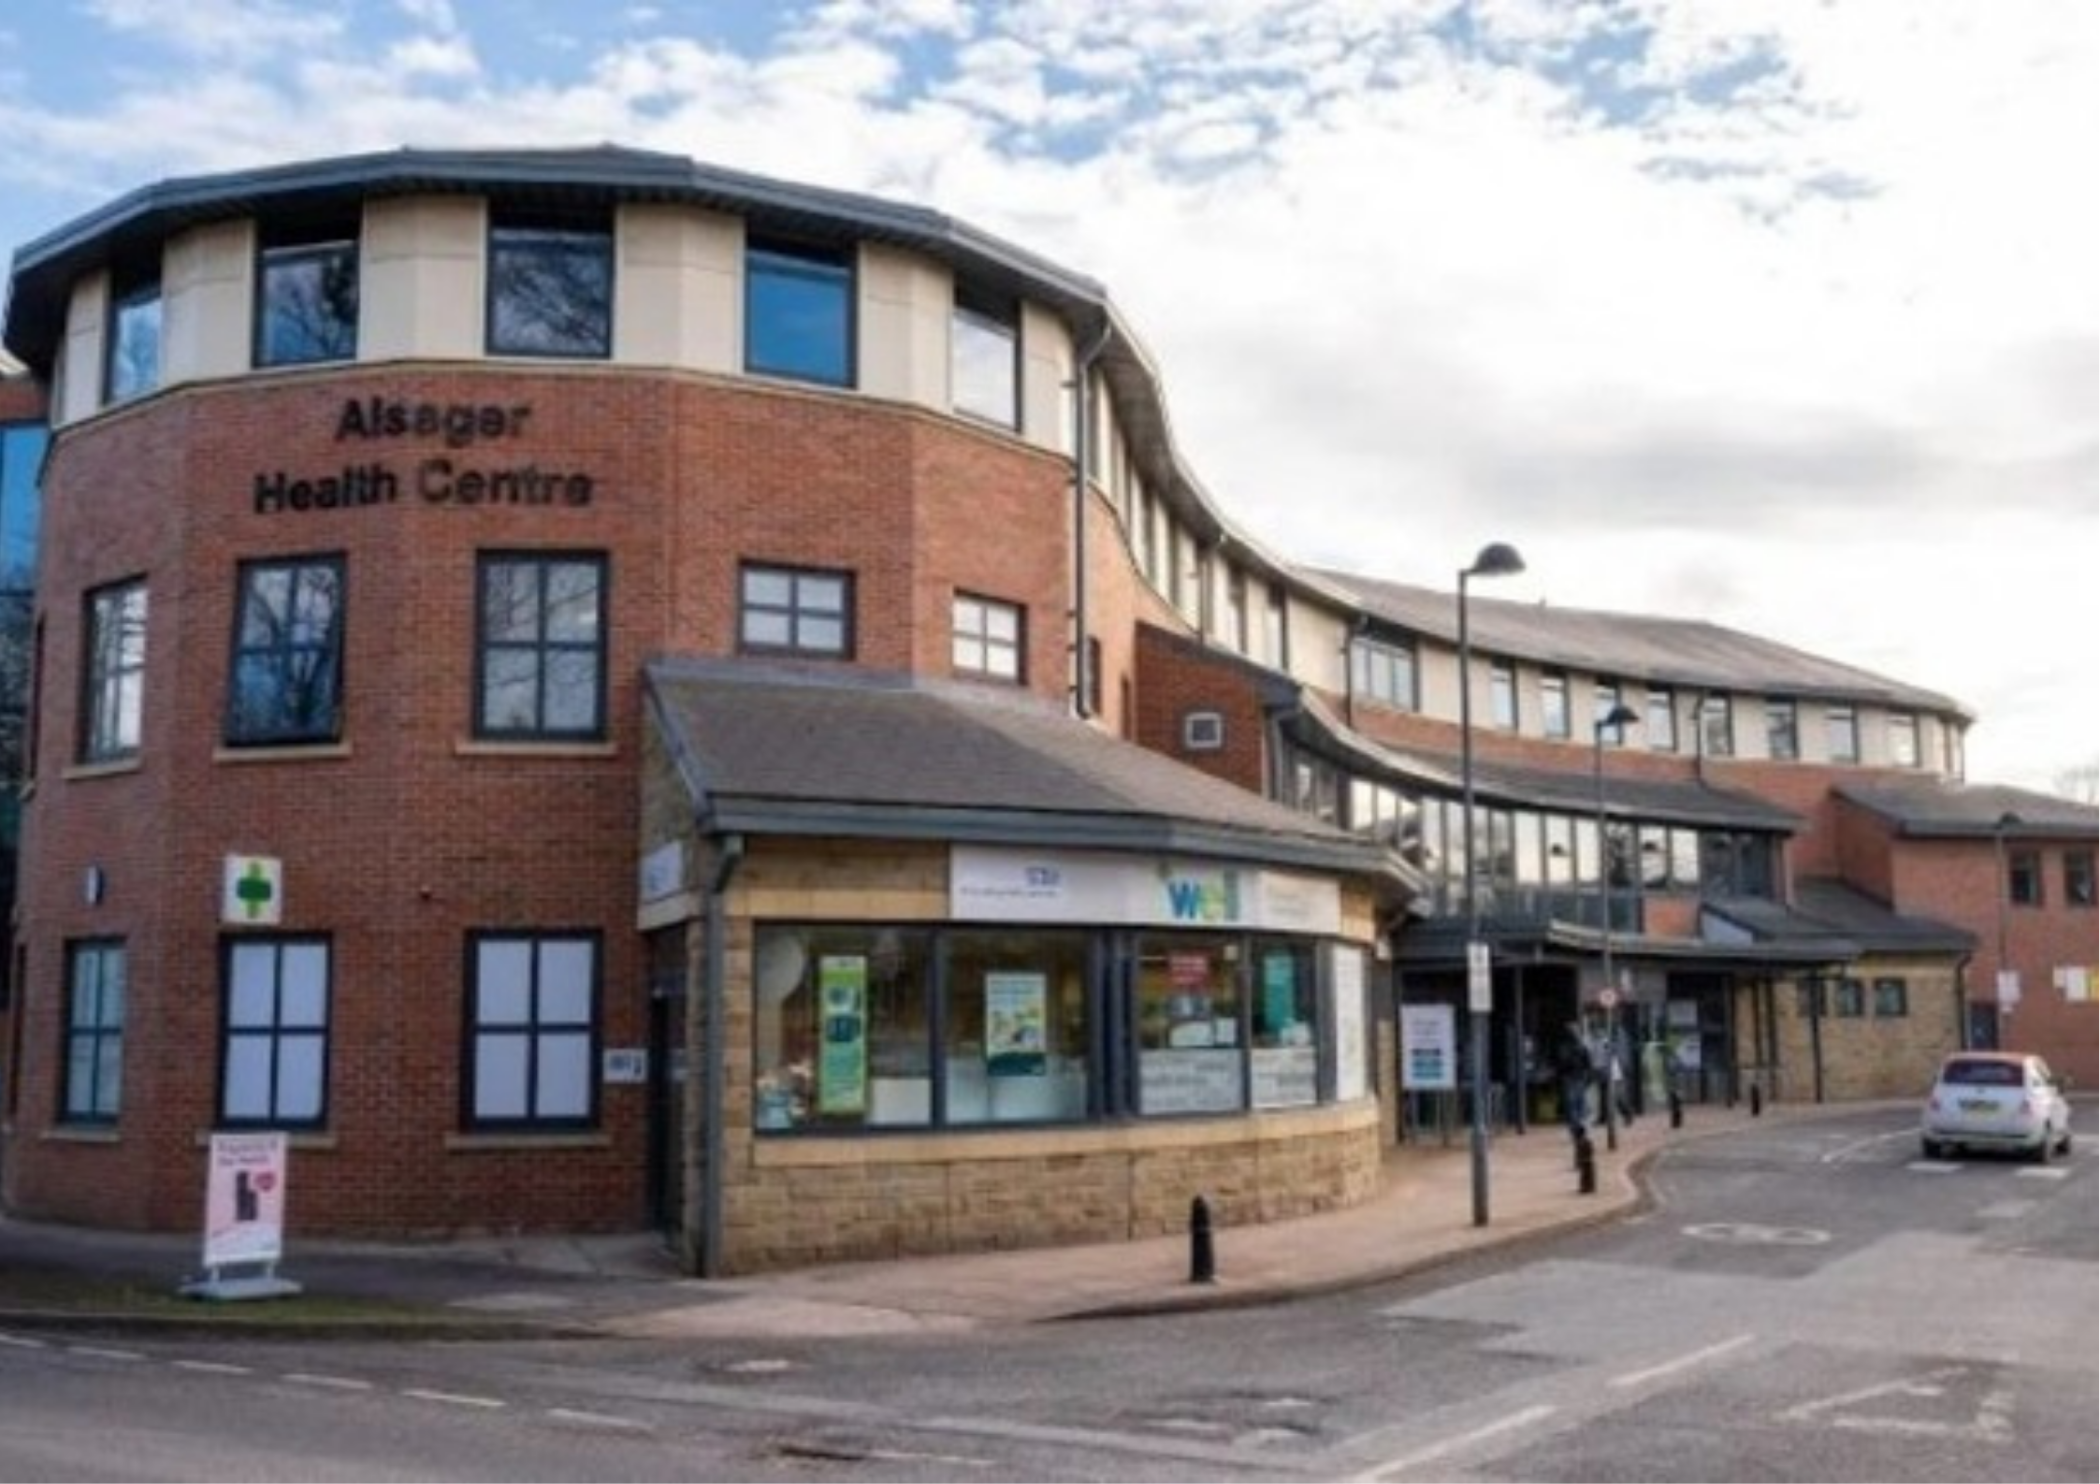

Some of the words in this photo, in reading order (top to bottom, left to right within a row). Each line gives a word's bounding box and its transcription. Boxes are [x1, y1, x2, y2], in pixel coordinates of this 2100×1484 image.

[335, 397, 532, 447] Alsager
[253, 463, 398, 514] Health
[418, 459, 595, 507] Centre
